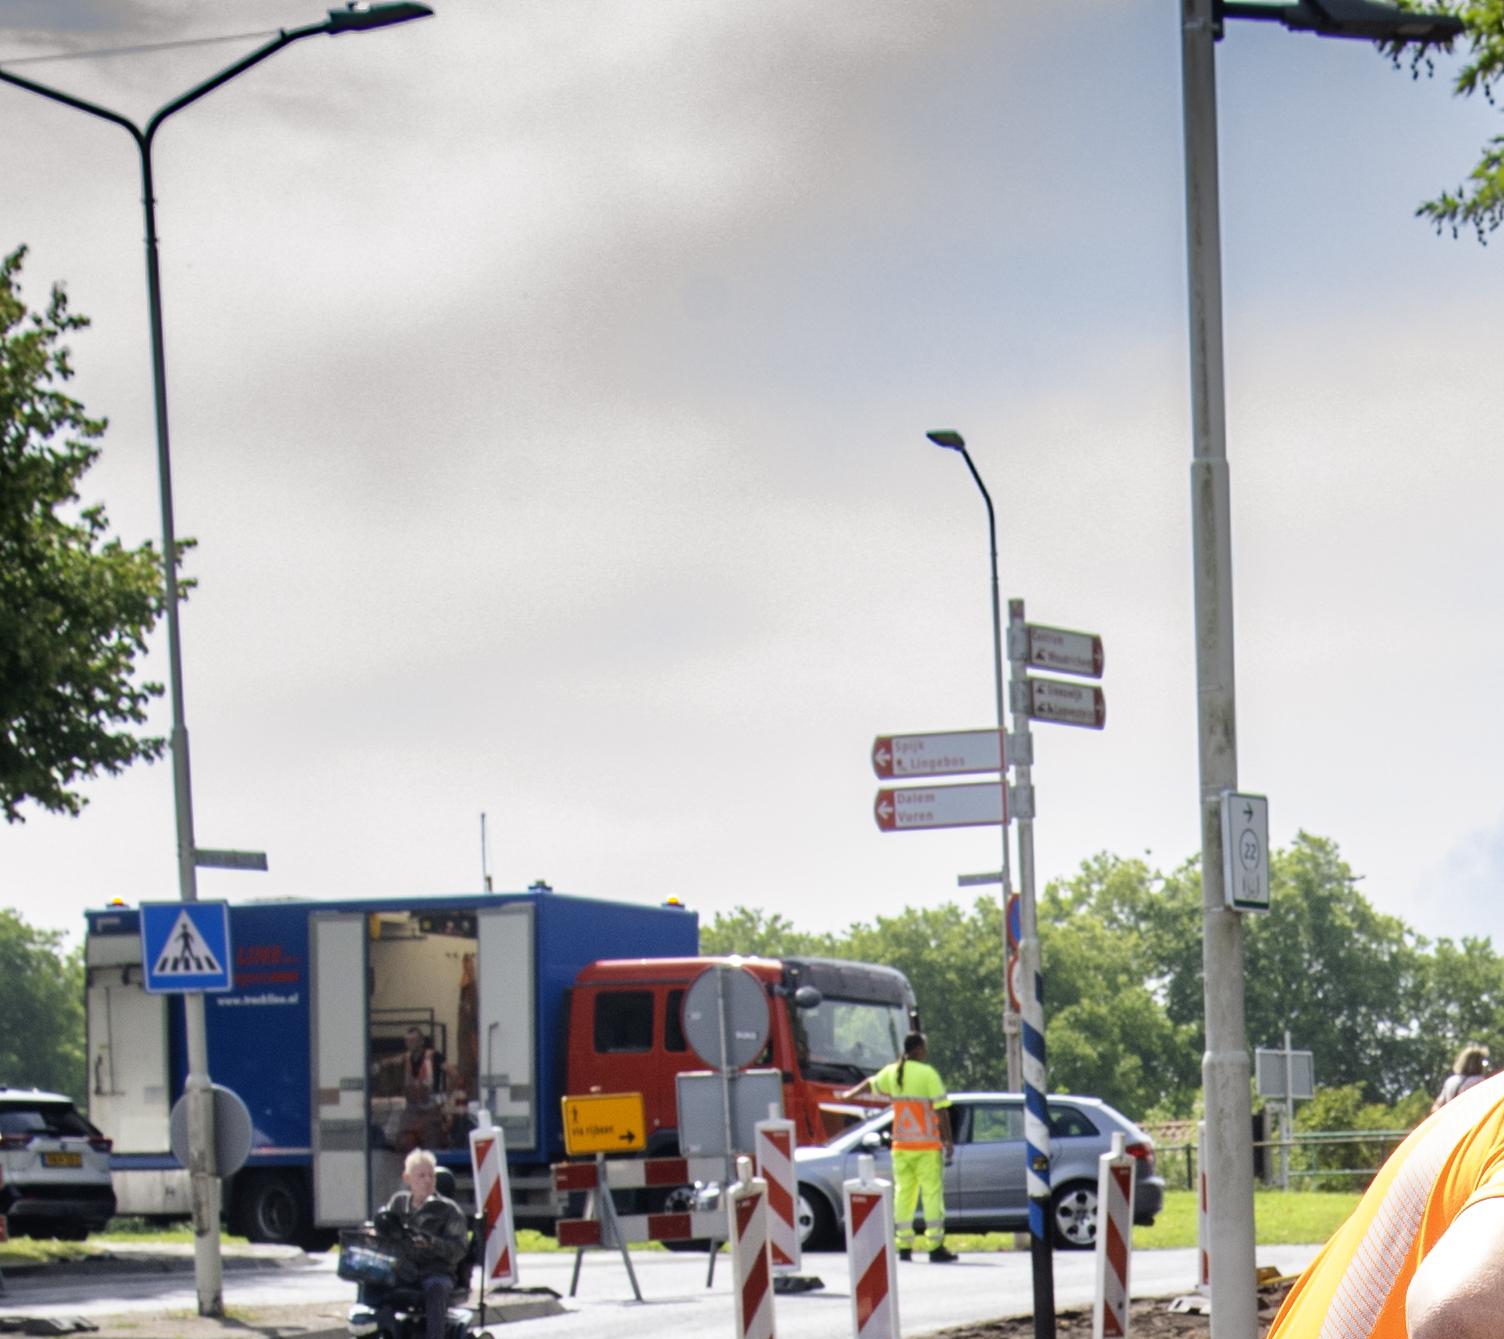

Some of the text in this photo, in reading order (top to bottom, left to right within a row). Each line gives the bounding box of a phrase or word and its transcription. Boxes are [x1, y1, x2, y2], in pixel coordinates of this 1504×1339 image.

[895, 740, 925, 754] Spijk
[897, 793, 936, 805] Dalem
[1244, 843, 1257, 861] 22
